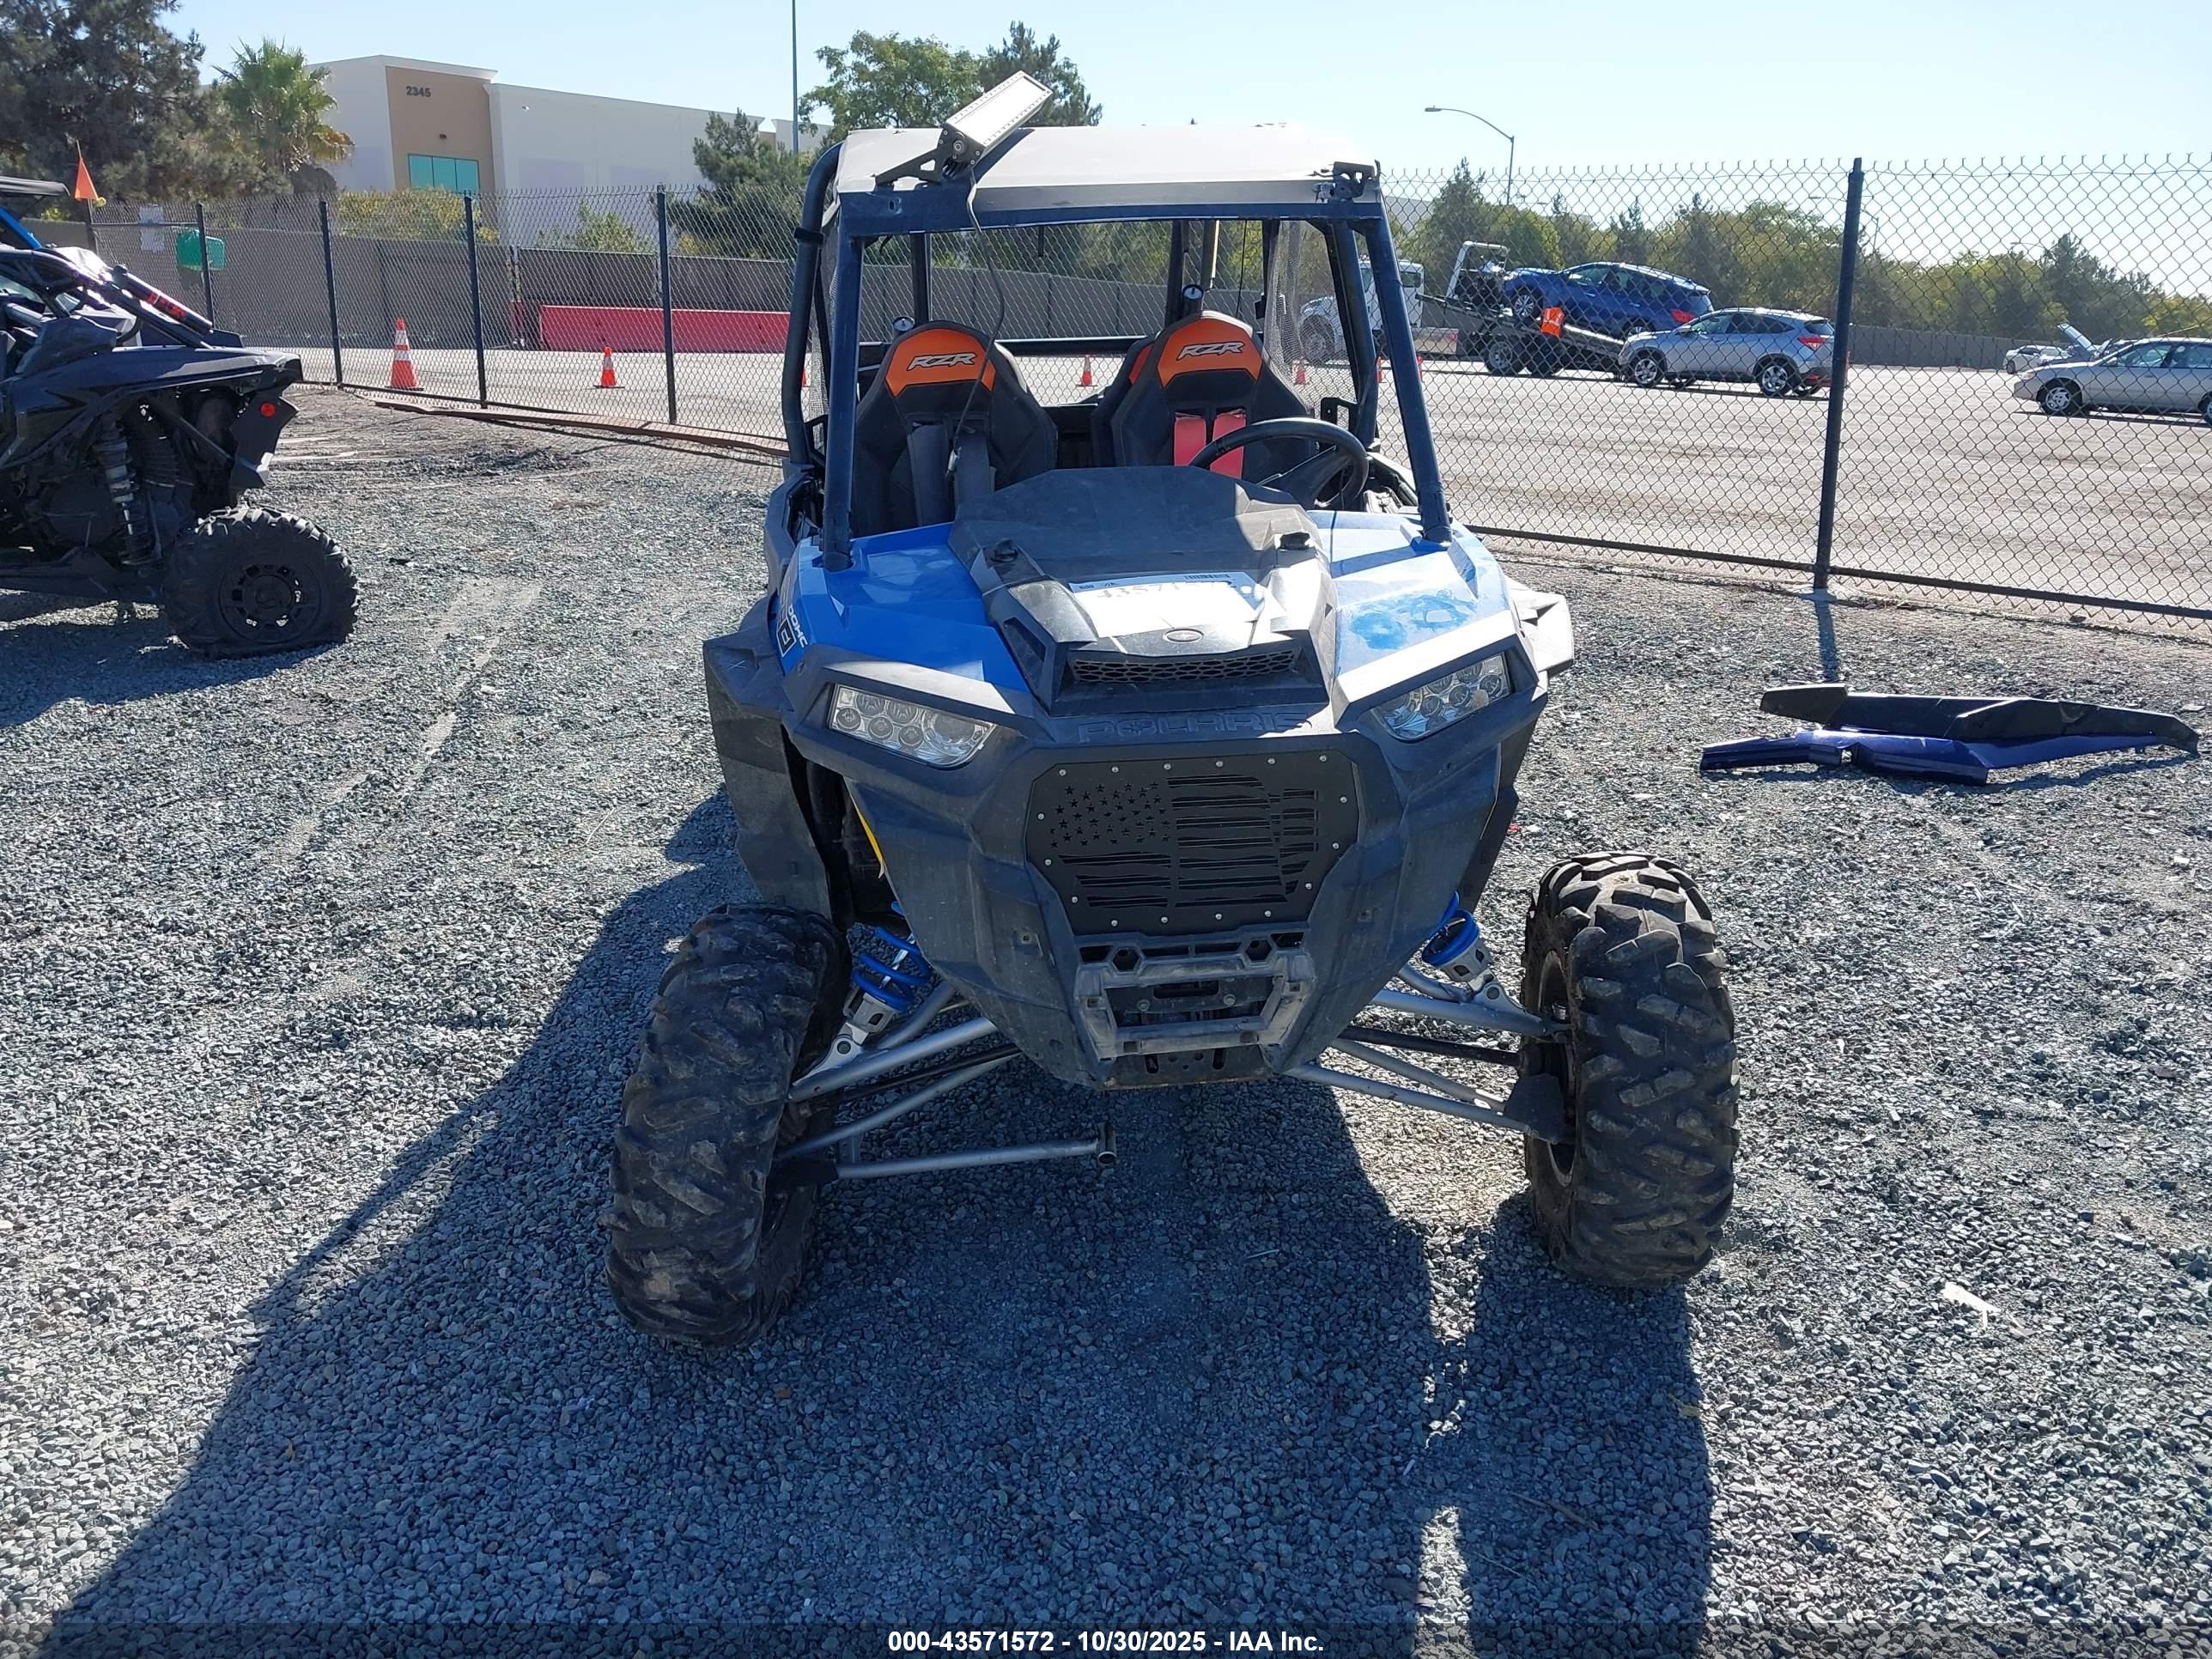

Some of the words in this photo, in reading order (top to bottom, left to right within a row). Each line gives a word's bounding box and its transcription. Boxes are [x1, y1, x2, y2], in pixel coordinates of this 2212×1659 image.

[405, 85, 432, 98] 2345
[907, 352, 976, 371] RZR
[1176, 341, 1244, 362] RZR
[1078, 712, 1312, 743] POLARIS
